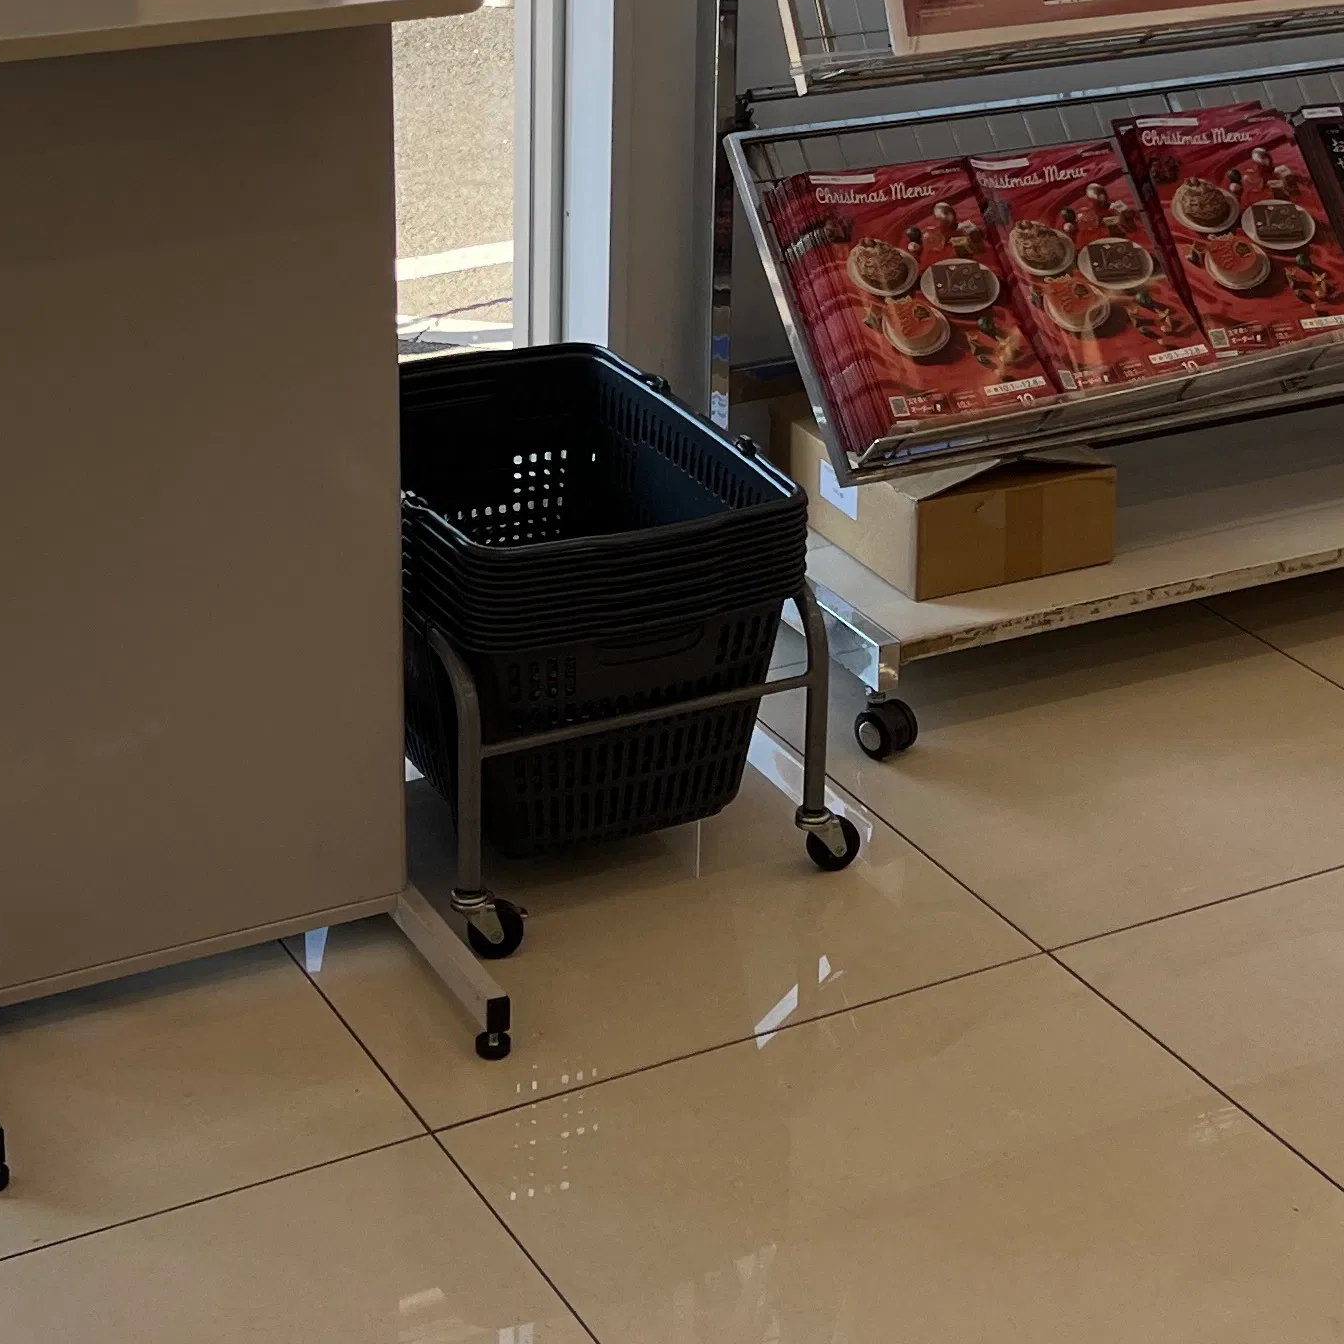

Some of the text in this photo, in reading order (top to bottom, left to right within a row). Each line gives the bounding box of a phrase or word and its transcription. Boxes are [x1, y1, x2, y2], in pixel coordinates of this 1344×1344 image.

[1141, 127, 1253, 147] Christmas Menu
[1044, 165, 1088, 183] Menu
[815, 182, 936, 204] Christmas Menu
